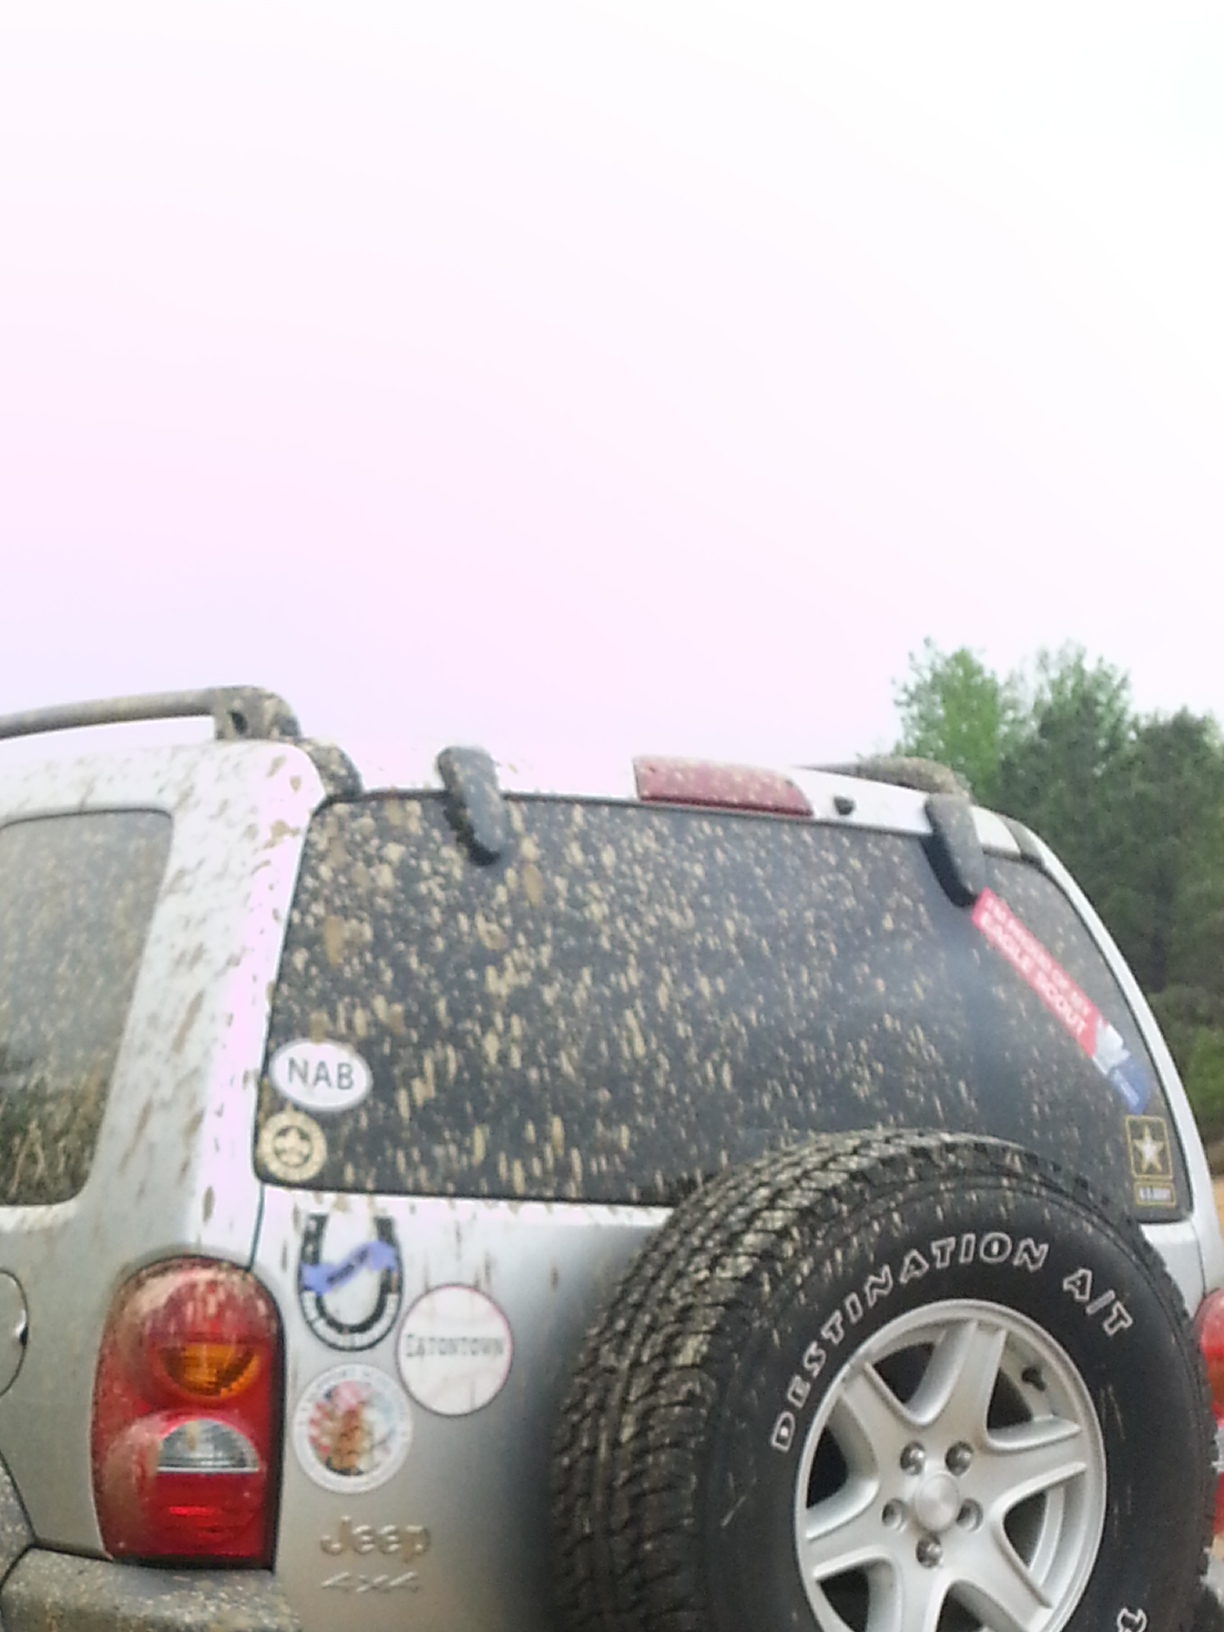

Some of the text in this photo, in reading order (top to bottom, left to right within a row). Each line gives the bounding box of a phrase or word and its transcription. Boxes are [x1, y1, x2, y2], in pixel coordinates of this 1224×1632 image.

[288, 1057, 355, 1091] NAB
[771, 1231, 1133, 1453] DESTINATION A/T
[320, 1515, 432, 1564] Jeep
